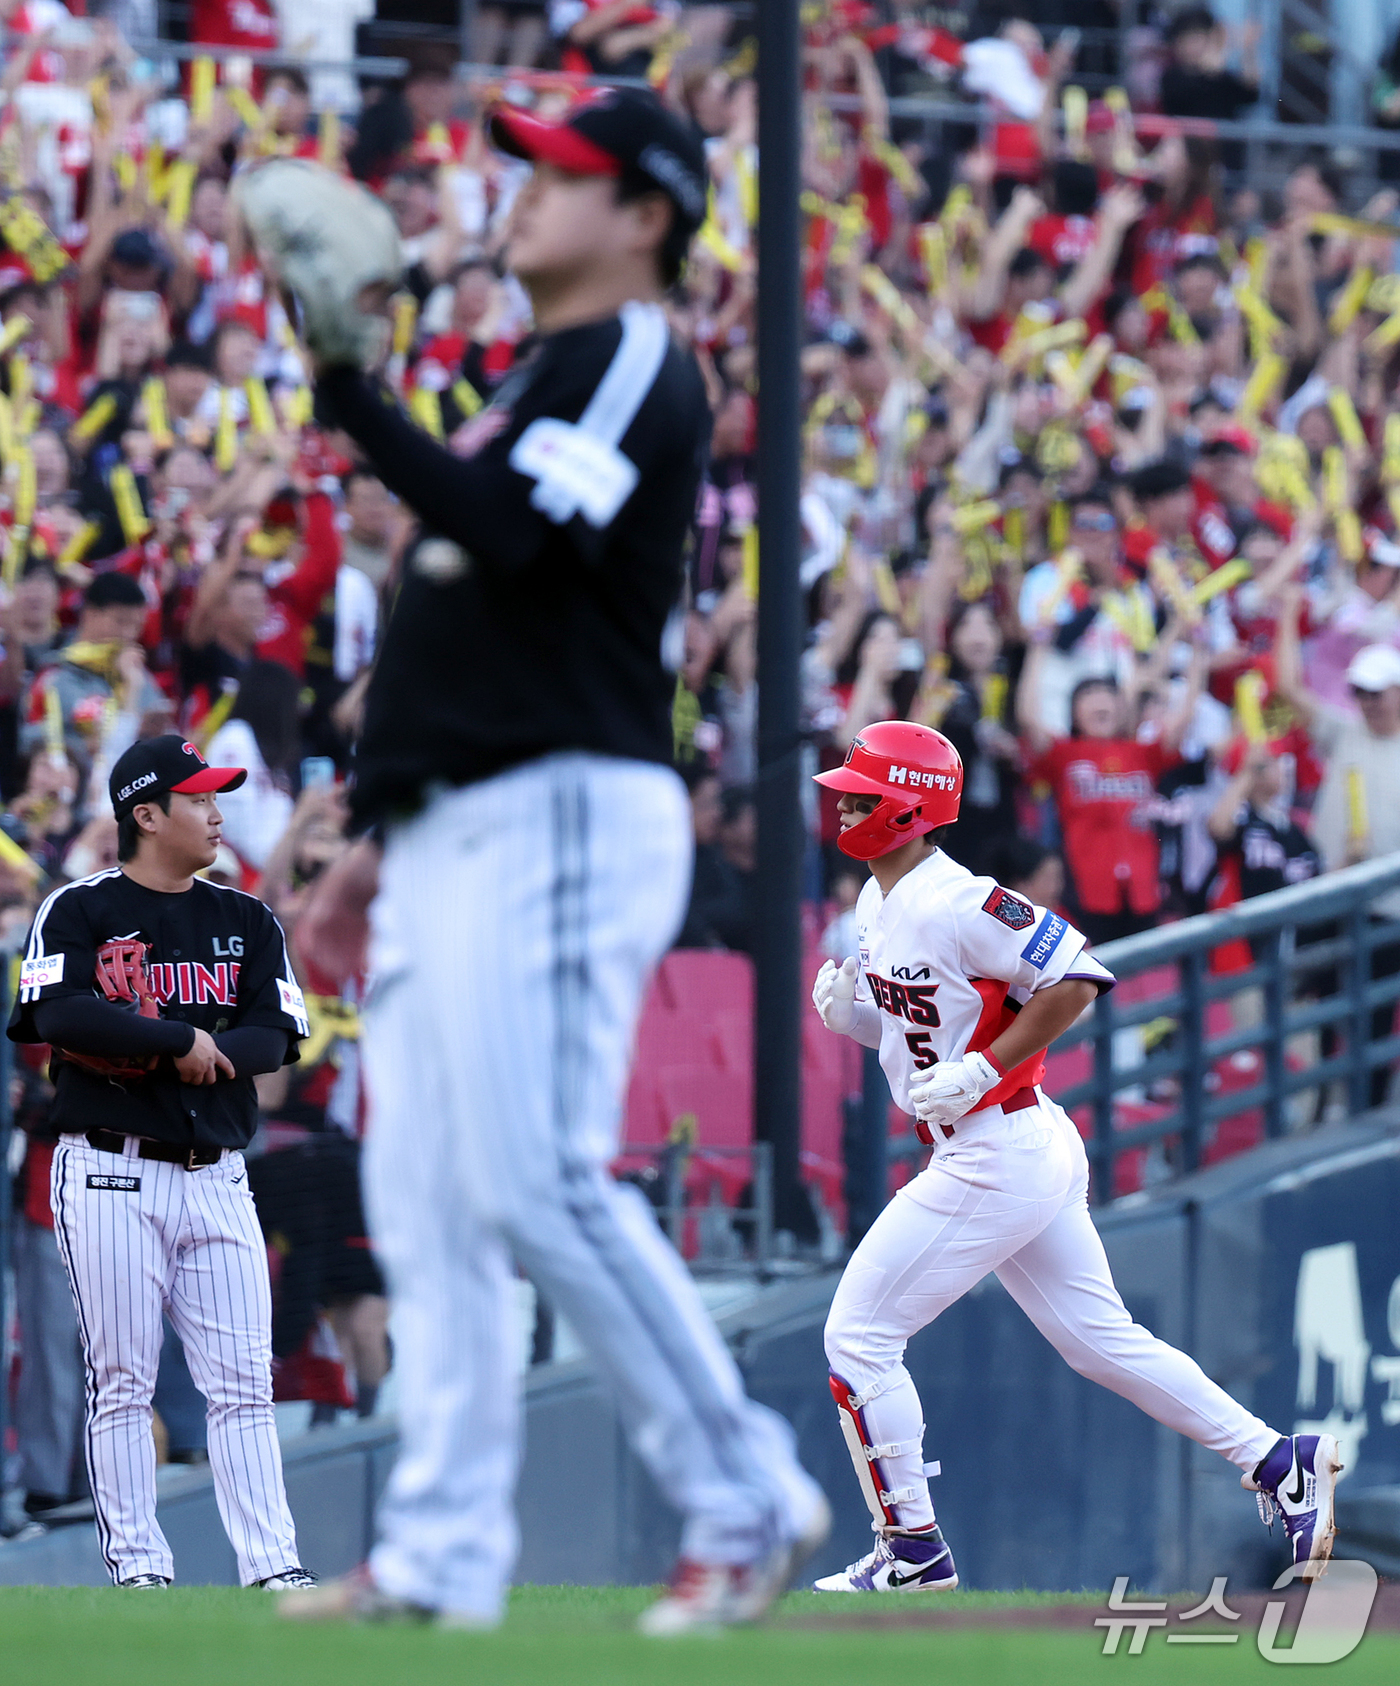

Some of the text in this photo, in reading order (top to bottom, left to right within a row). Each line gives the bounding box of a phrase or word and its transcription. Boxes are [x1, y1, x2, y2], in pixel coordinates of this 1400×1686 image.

[117, 771, 158, 801] LGE.COM
[908, 770, 956, 792] 현대해상
[212, 935, 245, 957] LG
[891, 965, 931, 981] KIA
[904, 1032, 940, 1071] 5
[91, 1177, 109, 1187] 영진
